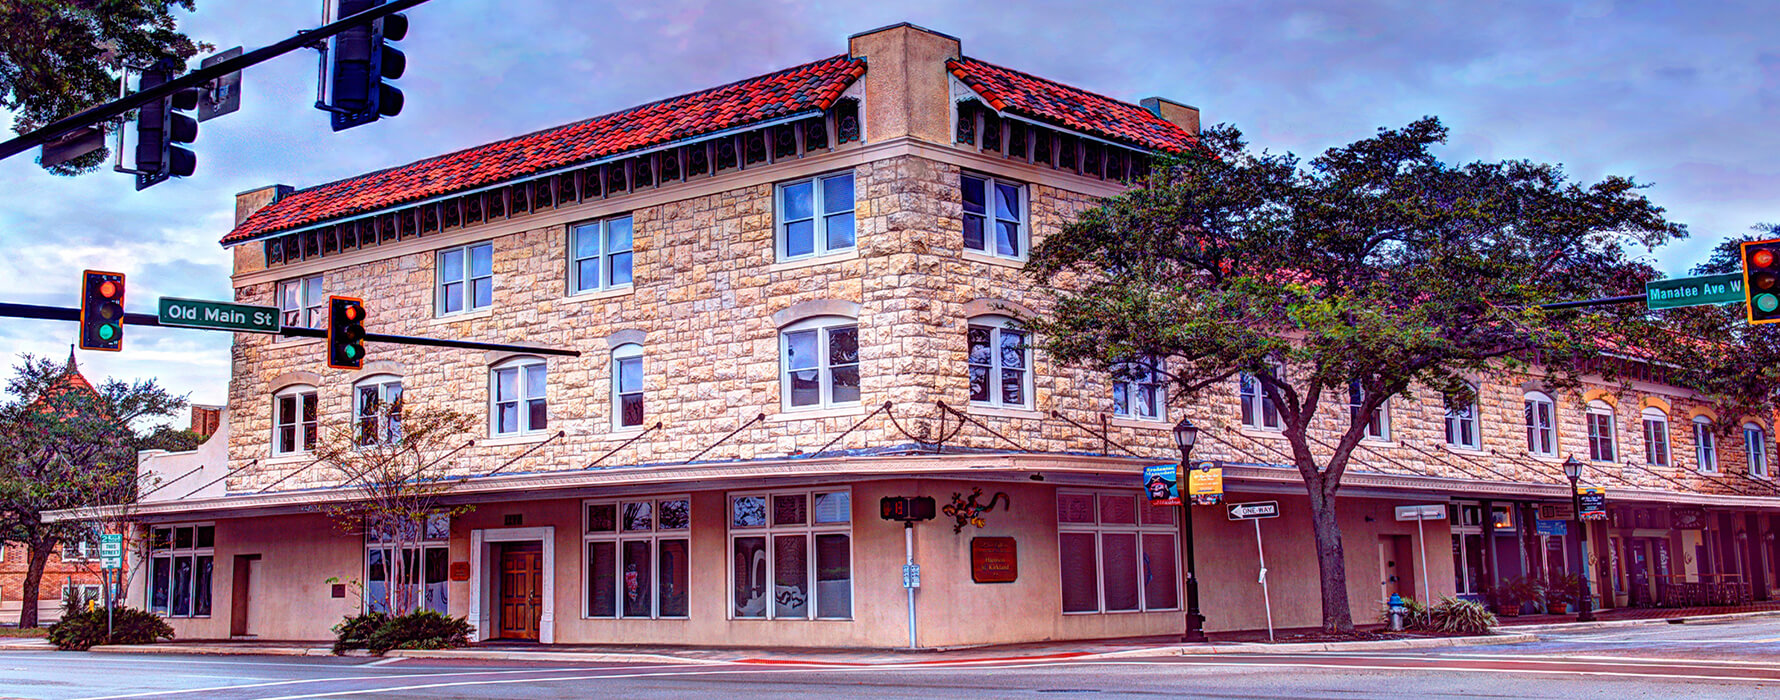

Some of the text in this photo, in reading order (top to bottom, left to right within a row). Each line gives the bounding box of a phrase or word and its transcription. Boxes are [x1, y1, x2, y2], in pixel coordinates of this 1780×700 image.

[1649, 280, 1741, 300] Manatee Ave W
[168, 304, 272, 326] Old Main St
[895, 501, 903, 515] 13
[1242, 505, 1273, 515] ONE WAY
